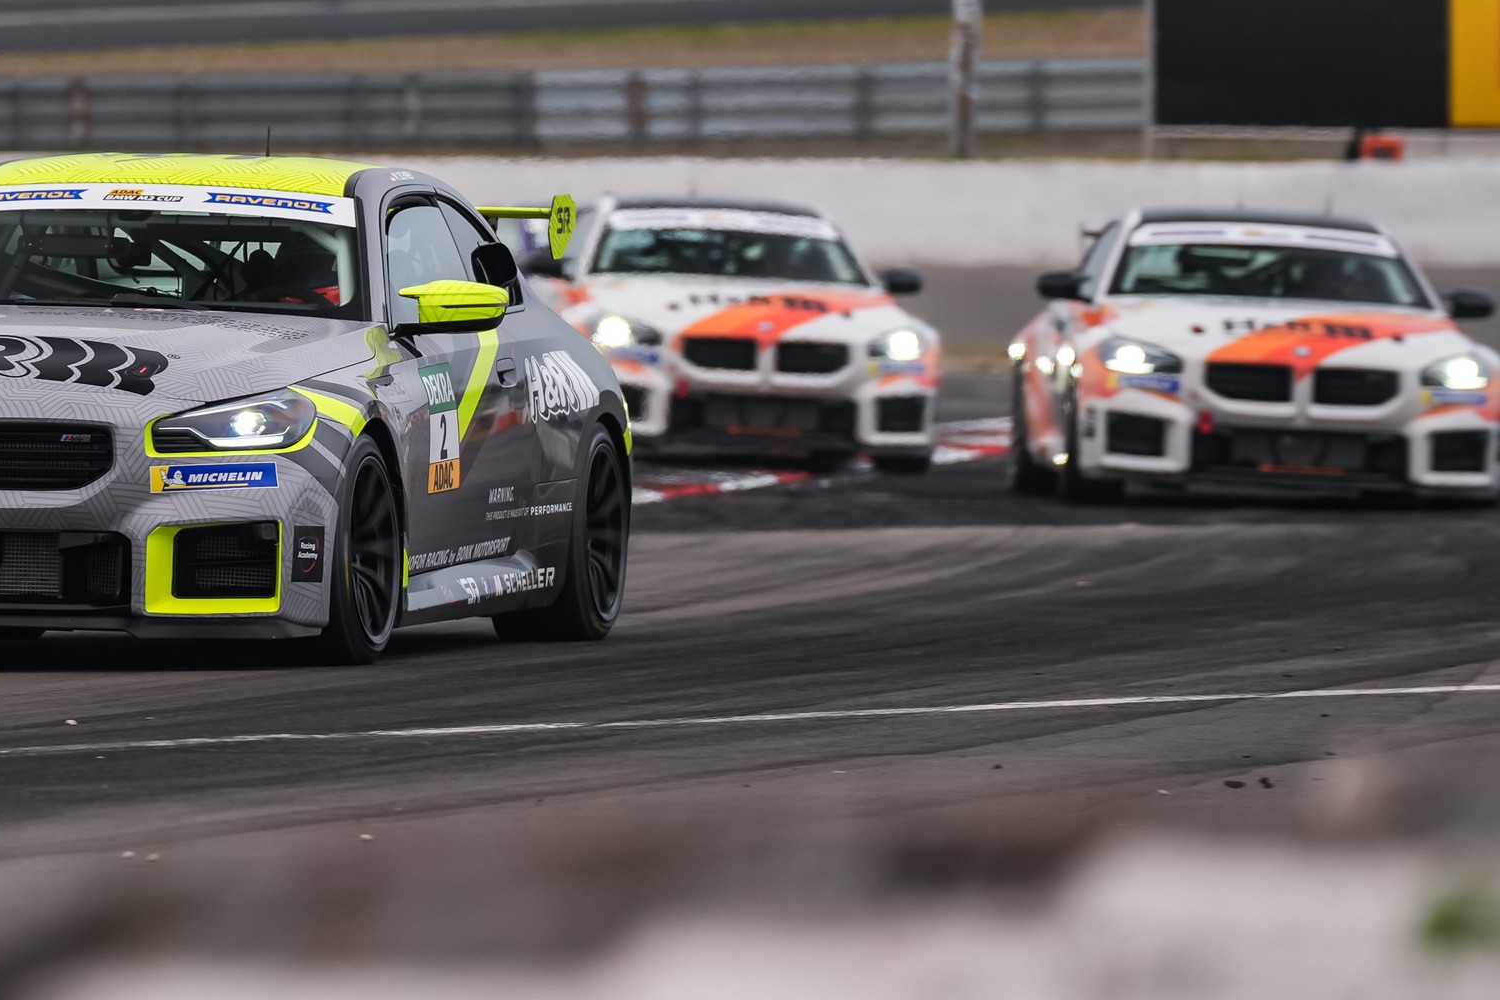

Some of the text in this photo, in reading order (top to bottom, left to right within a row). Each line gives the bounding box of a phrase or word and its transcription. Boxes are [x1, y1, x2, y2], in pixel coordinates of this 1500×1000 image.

[214, 193, 325, 211] RAVENOL
[421, 371, 455, 406] DEKRA
[524, 352, 581, 424] H&R
[440, 413, 448, 460] 2
[187, 471, 263, 483] MICHELIN
[432, 461, 454, 491] ADAC
[530, 502, 572, 516] PERFORMANCE
[297, 551, 319, 560] Academy
[300, 541, 316, 552] Racing
[426, 549, 450, 568] RACING
[449, 548, 455, 566] by
[456, 545, 473, 562] BONK
[473, 536, 511, 560] MOTORSPORT
[503, 566, 556, 595] SCHELLER
